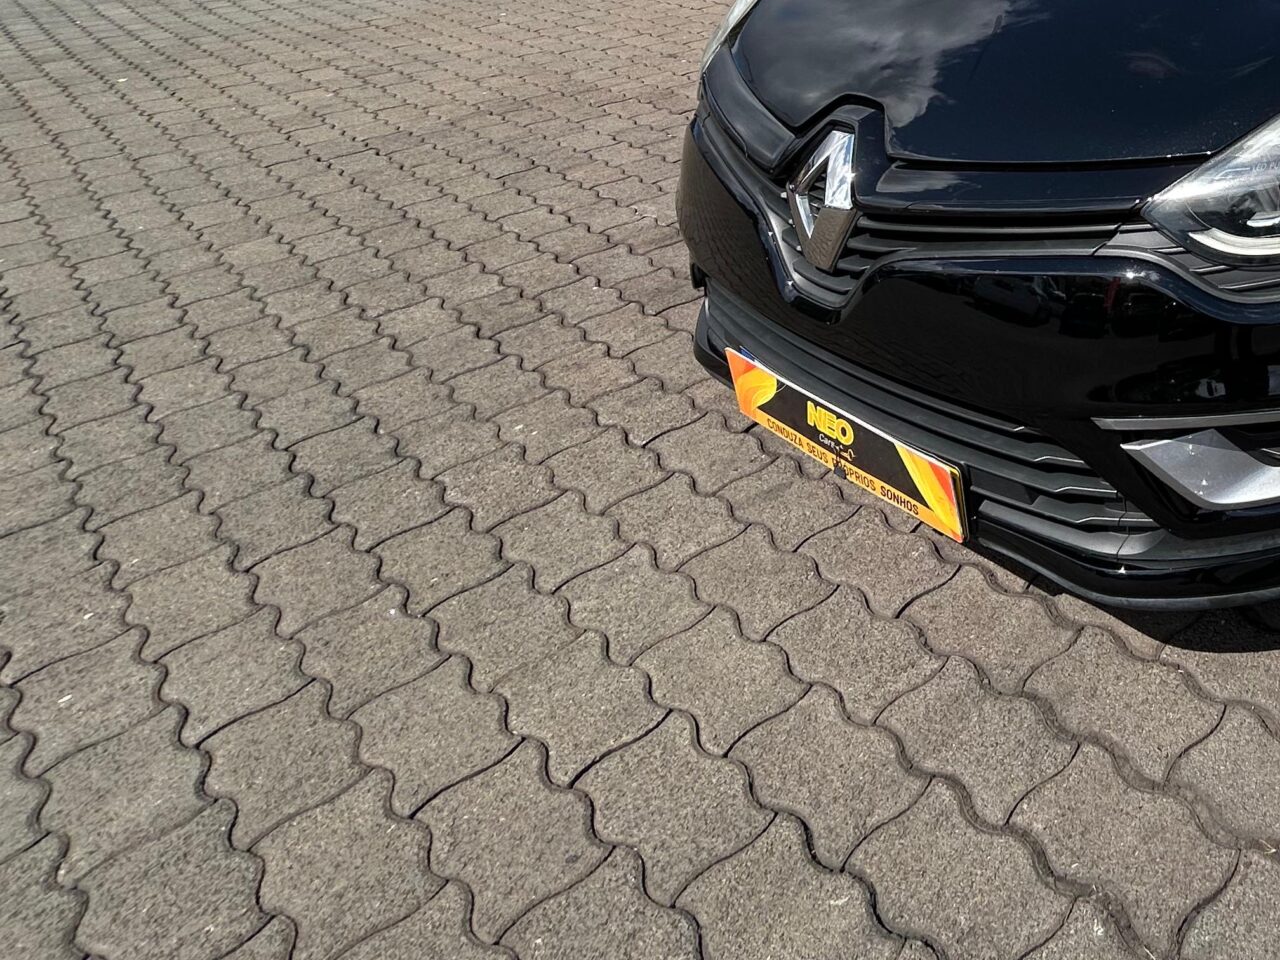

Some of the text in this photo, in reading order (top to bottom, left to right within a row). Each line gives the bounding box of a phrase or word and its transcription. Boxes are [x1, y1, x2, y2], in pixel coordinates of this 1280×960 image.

[806, 400, 855, 446] NEO
[766, 418, 804, 448] CONDUZA
[806, 442, 829, 464] SEUS
[880, 485, 919, 516] SONHOS
